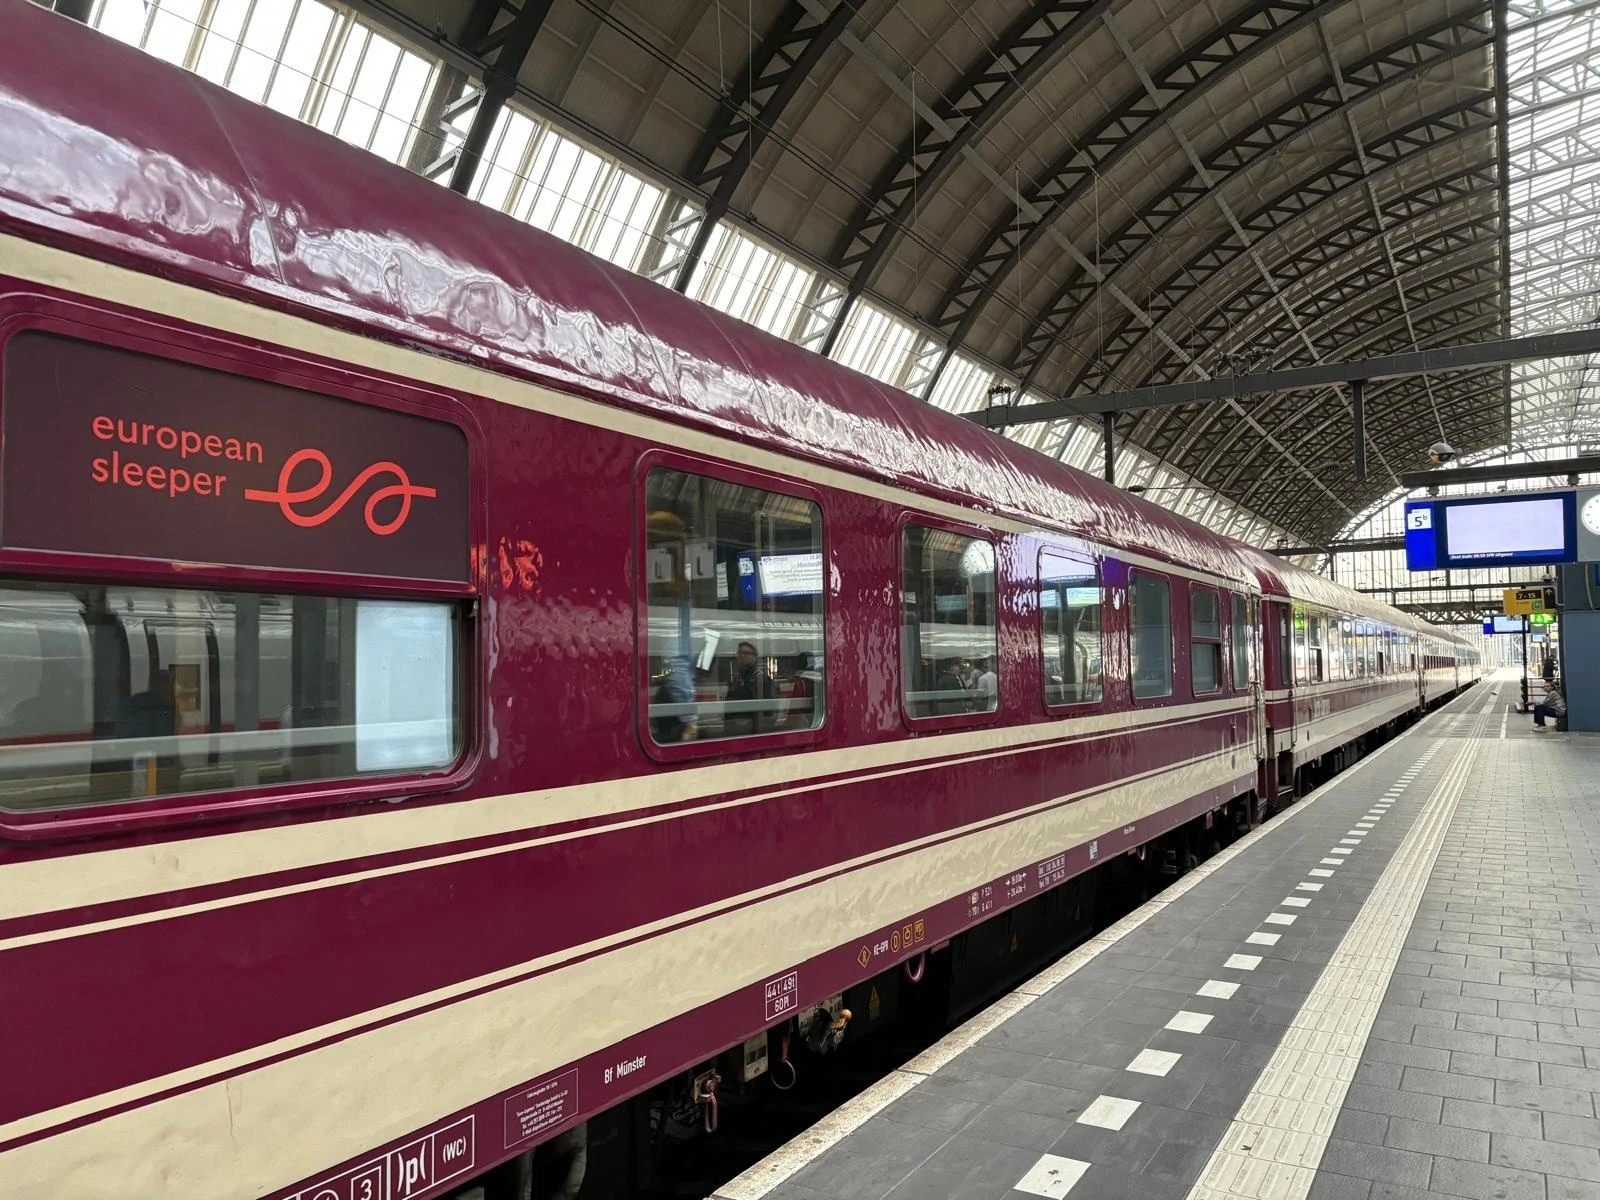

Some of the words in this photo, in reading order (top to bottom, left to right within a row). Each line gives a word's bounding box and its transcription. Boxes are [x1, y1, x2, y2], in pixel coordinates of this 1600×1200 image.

[91, 415, 264, 464] european
[91, 450, 227, 497] sleeper
[604, 1066, 614, 1085] Bf
[616, 1055, 647, 1079] Münster
[360, 1178, 372, 1200] 3
[442, 1136, 467, 1164] (WC)
